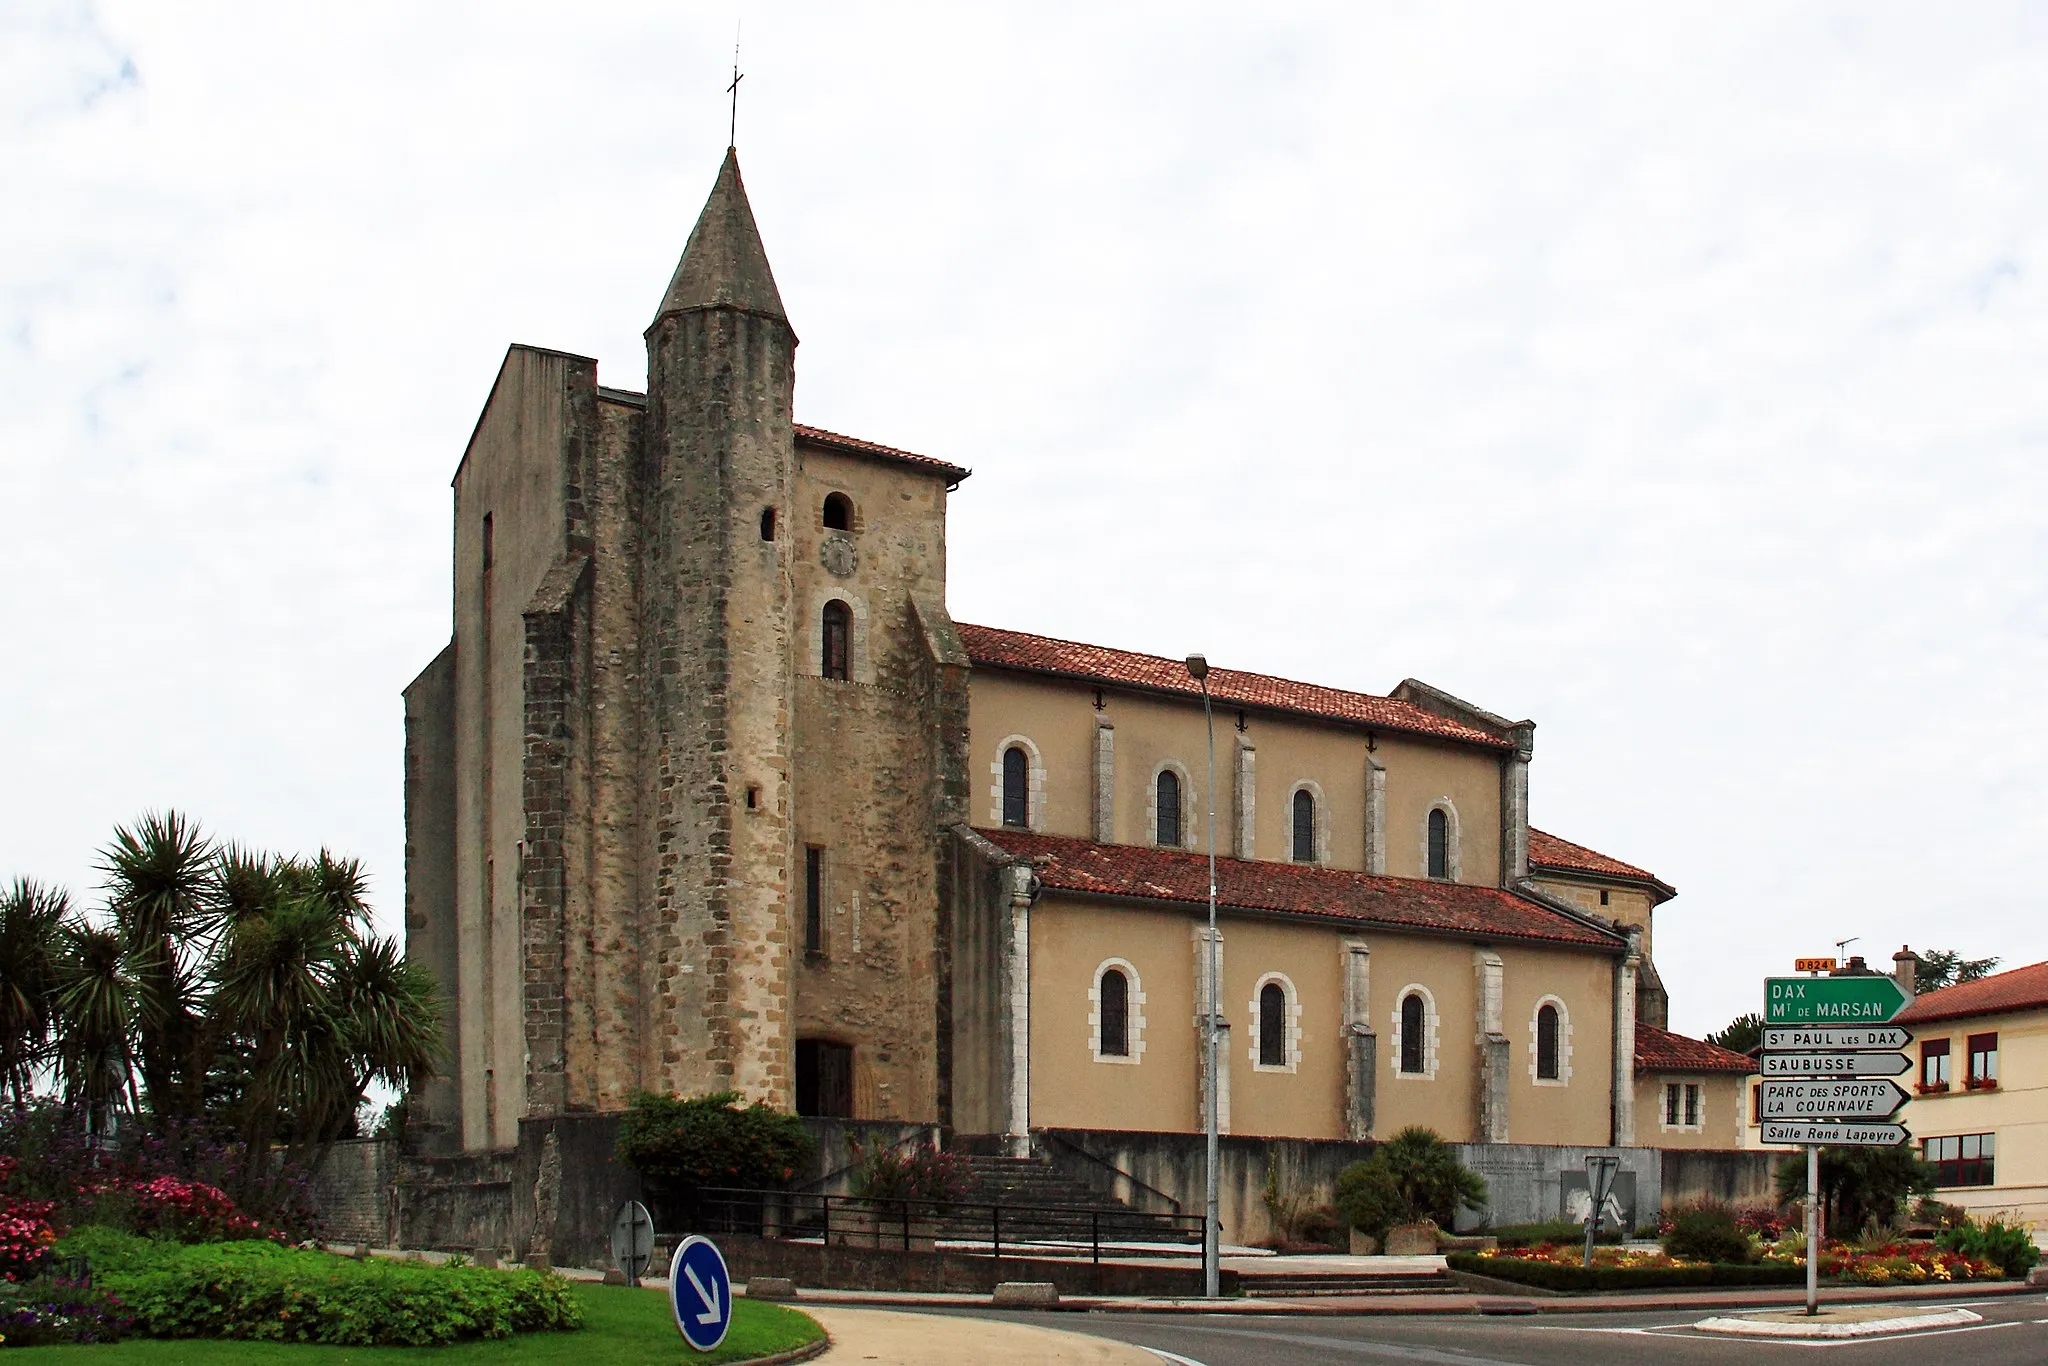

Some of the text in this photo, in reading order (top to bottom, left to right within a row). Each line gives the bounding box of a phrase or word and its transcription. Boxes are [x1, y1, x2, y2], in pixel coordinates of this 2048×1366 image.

[1798, 961, 1804, 969] D
[1772, 985, 1805, 998] DAX
[1772, 1003, 1882, 1017] MT DE MARSAN
[1770, 1033, 1896, 1044] ST PAUL LES DAX
[1768, 1059, 1854, 1070] SAUBUSSE
[1768, 1085, 1886, 1098] PARC DES SPORTS
[1768, 1100, 1873, 1112] LA COURNAVE
[1768, 1127, 1895, 1142] Salle René Lapeyre
